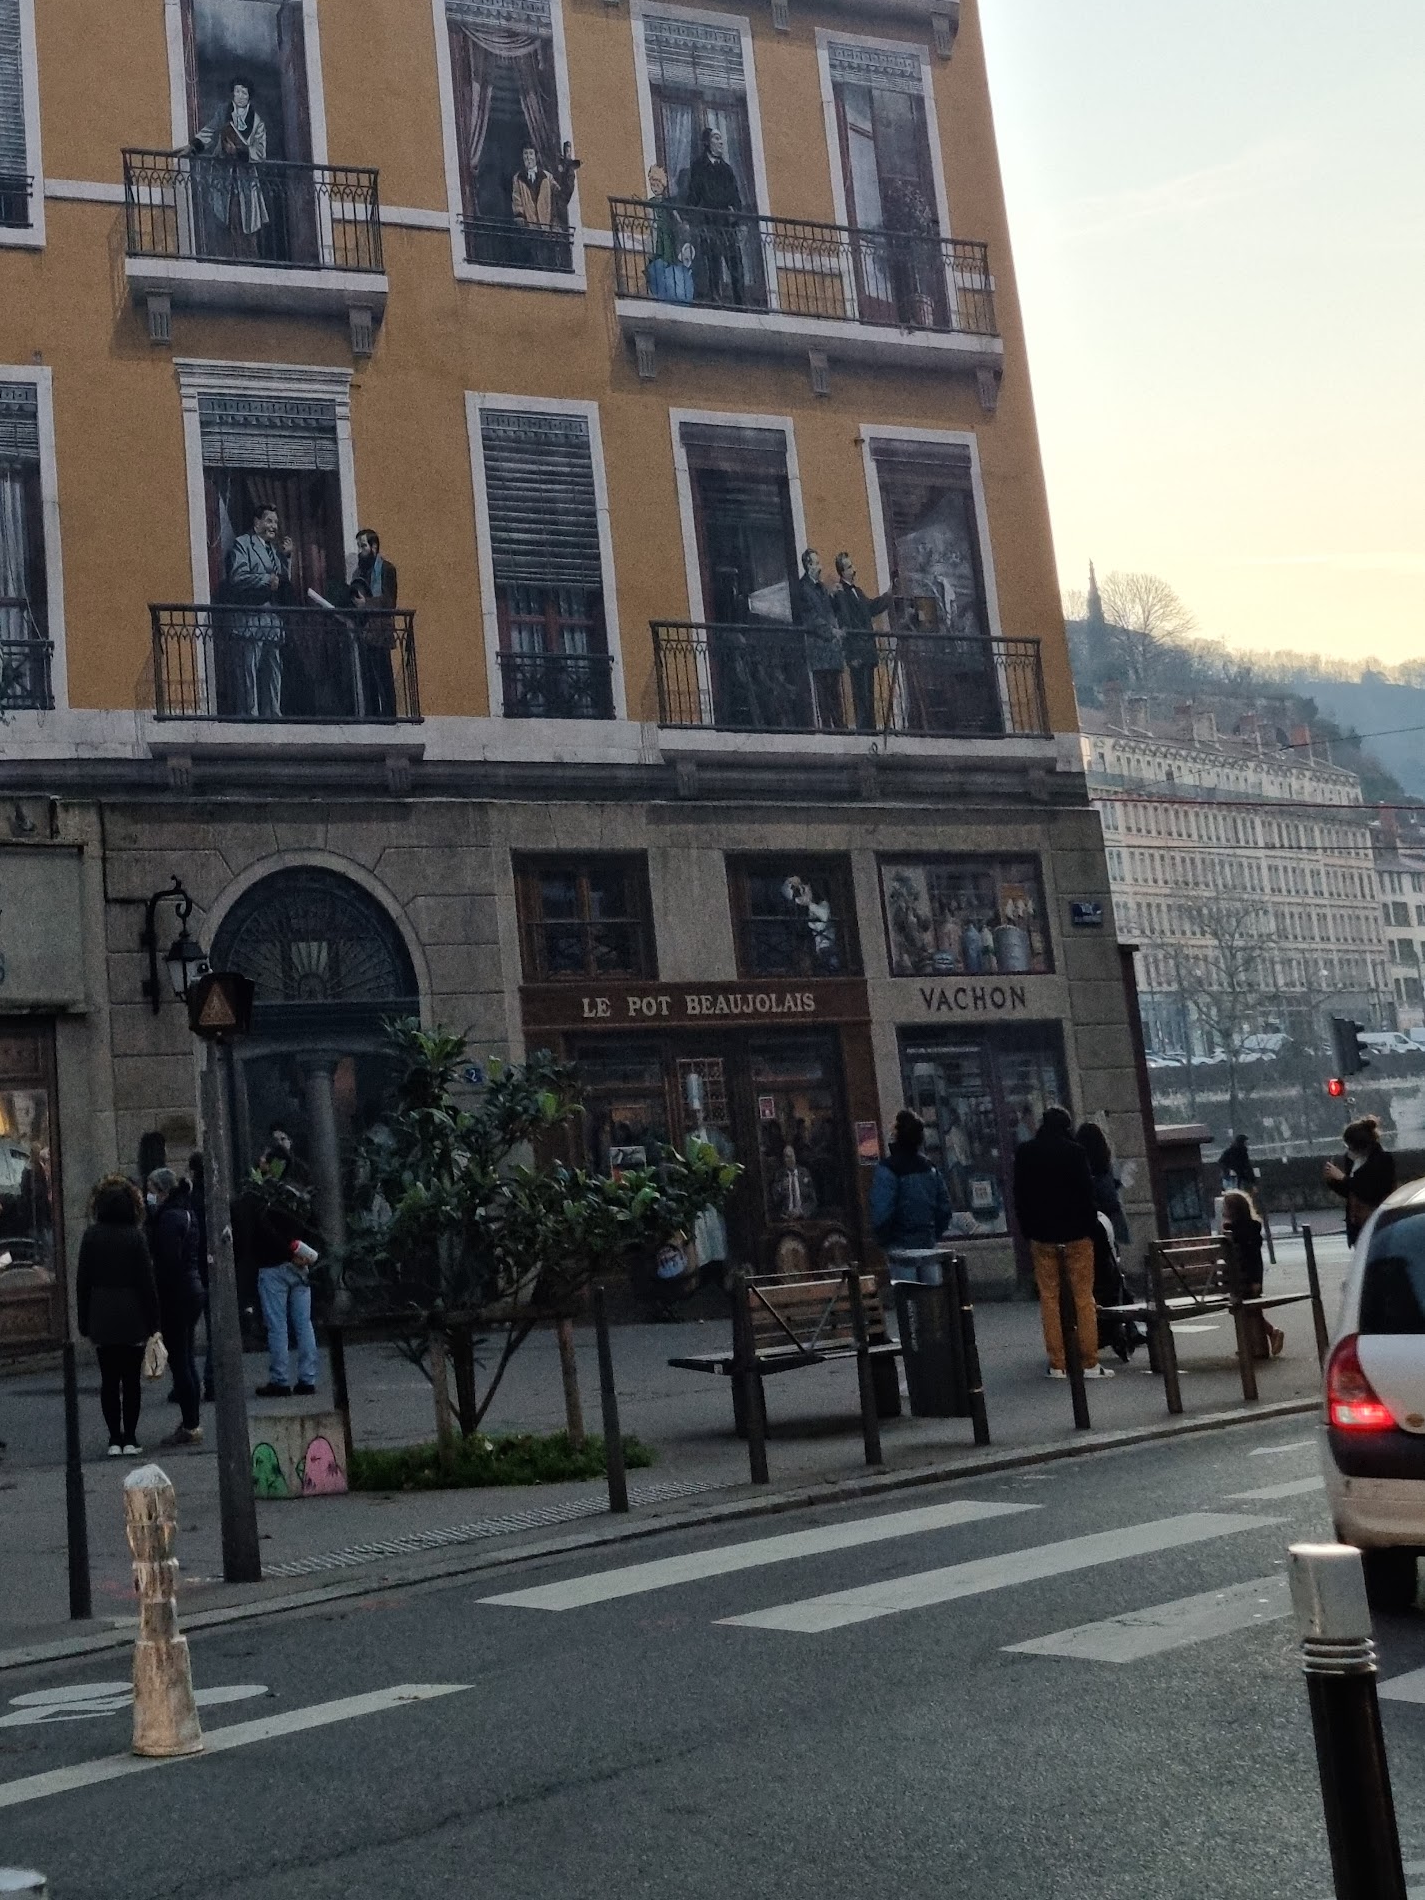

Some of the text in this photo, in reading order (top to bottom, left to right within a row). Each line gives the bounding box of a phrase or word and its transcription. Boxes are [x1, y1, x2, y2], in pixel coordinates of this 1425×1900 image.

[581, 992, 816, 1018] LE POT BEAUJOLAIS
[919, 985, 1027, 1012] VACHON
